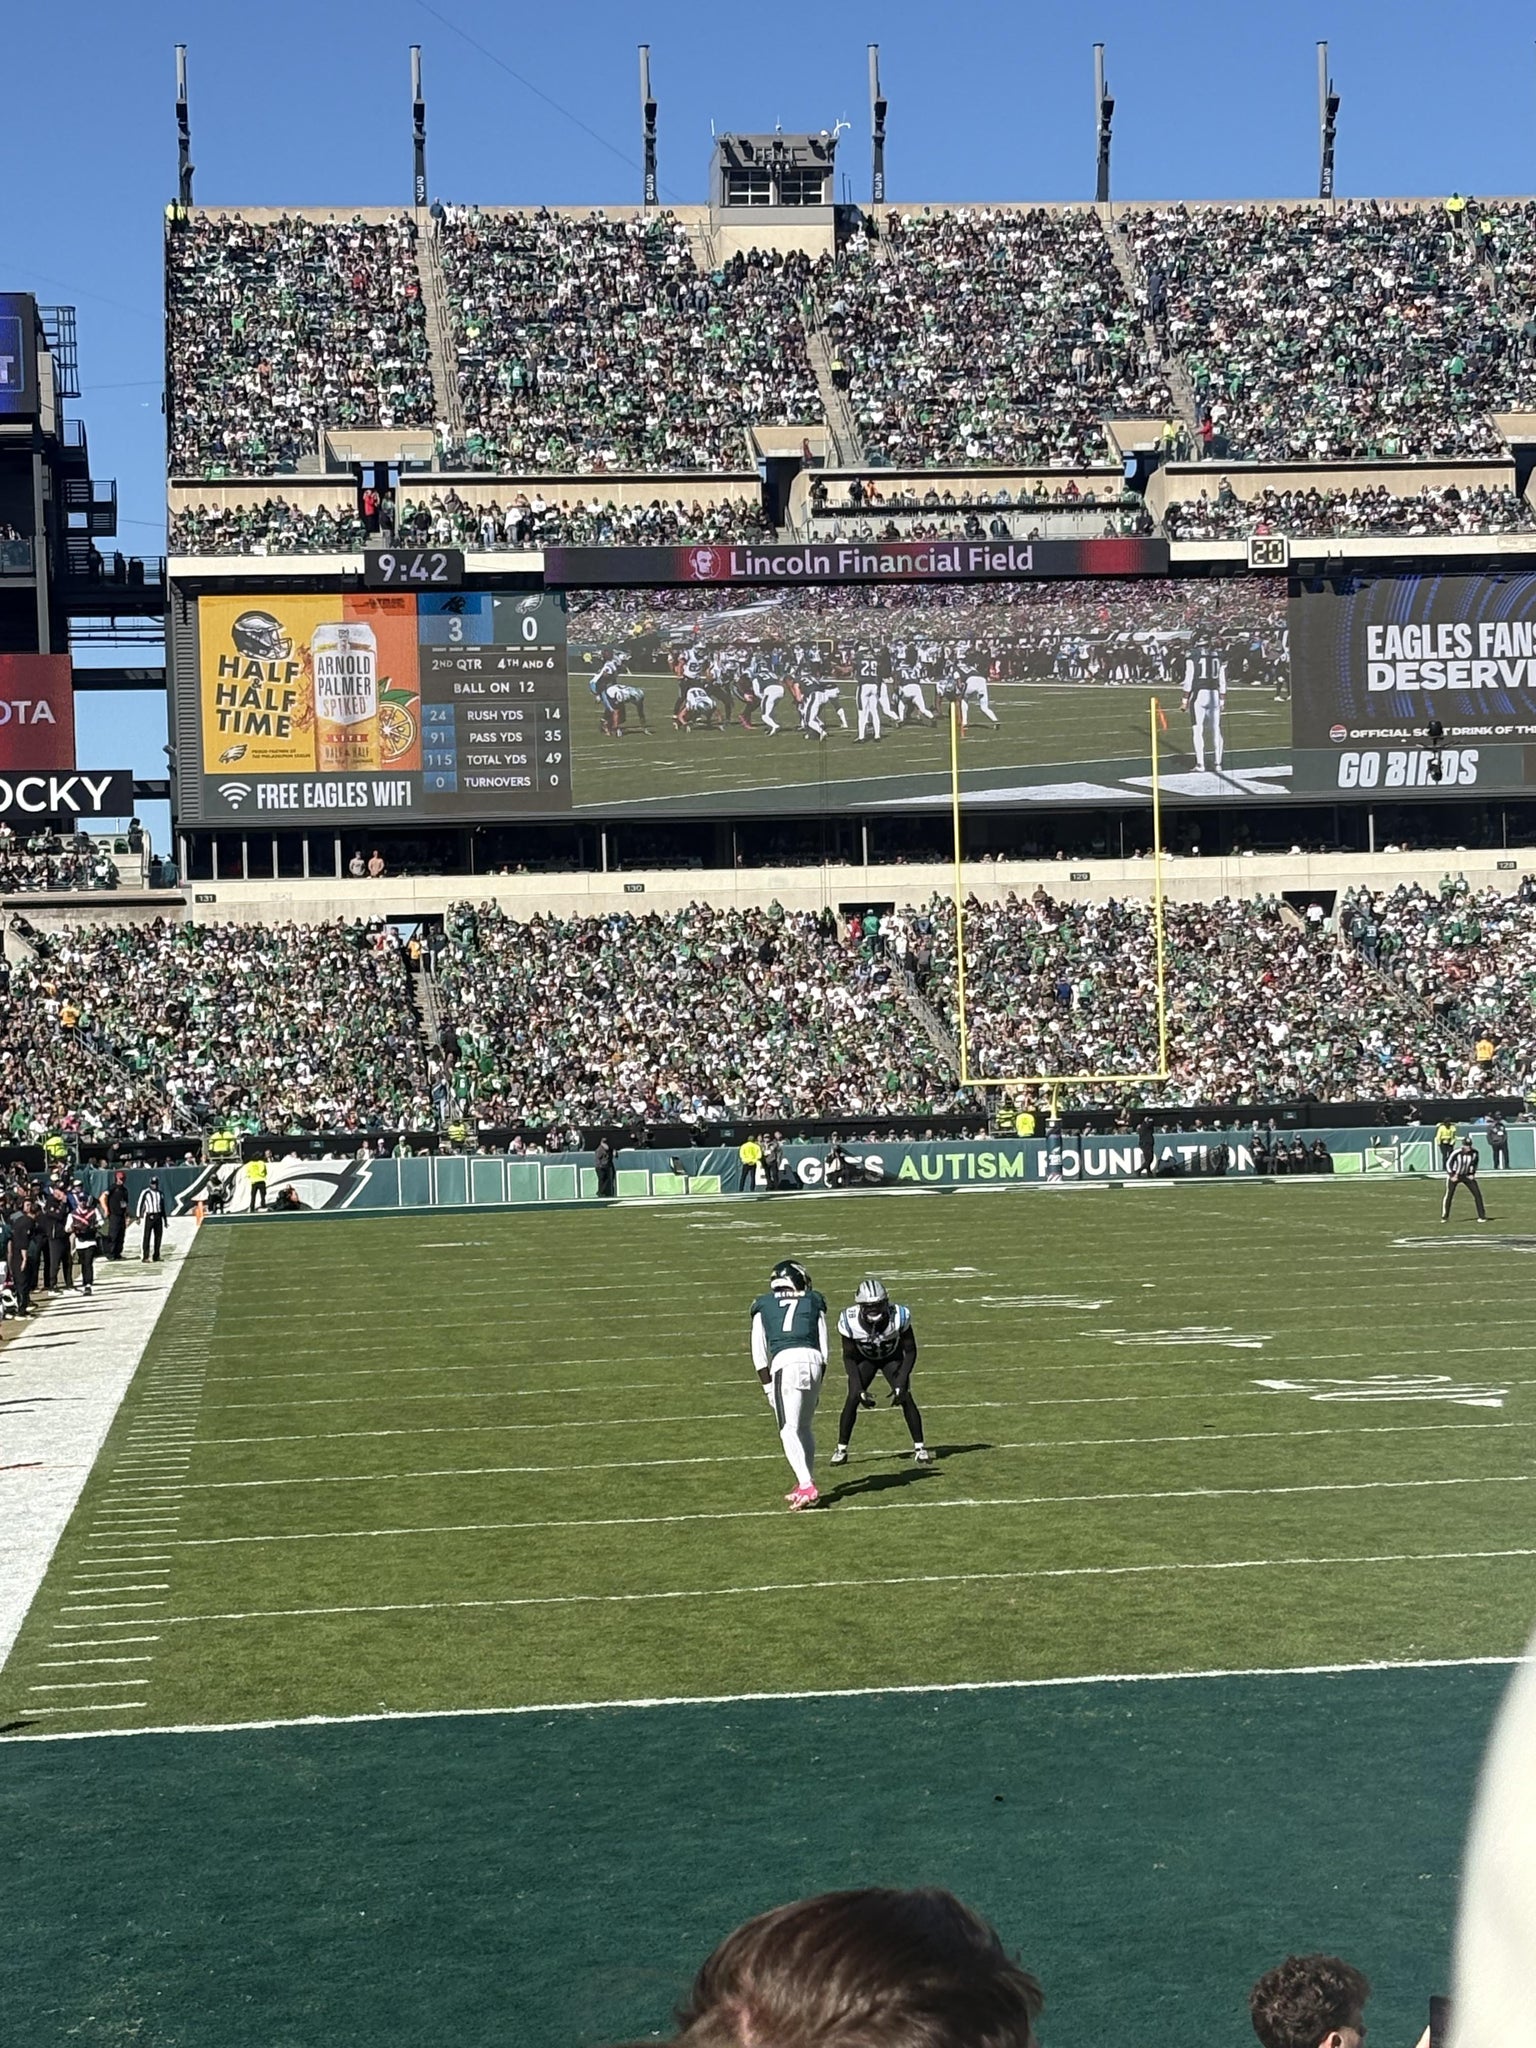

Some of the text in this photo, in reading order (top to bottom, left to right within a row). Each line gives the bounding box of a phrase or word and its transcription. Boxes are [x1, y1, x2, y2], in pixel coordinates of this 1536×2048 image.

[416, 176, 424, 202] 237
[1322, 168, 1331, 193] 234
[730, 545, 1034, 575] Lincoln Financial Field
[1253, 541, 1283, 564] 20
[378, 553, 448, 582] 9:42
[448, 617, 463, 642] 3
[522, 617, 538, 641] 0
[1366, 623, 1472, 660] EAGLES
[218, 655, 299, 684] HALF
[318, 656, 370, 675] ARNOLD
[432, 658, 482, 671] 2ND QTR
[497, 658, 555, 669] 4TH AND 6
[252, 678, 262, 689] &
[318, 677, 371, 696] PALMER
[454, 682, 535, 693] BALL ON 12
[216, 684, 297, 713] HALF
[323, 697, 366, 717] SPIKED
[216, 709, 291, 738] TIME
[430, 708, 561, 721] 24 RUSH YDS 14
[430, 730, 561, 743] 91 PASS YDS 35
[1350, 728, 1411, 738] OFFICIAL
[1413, 727, 1450, 737] SOT
[1452, 726, 1493, 736] DRINK
[1494, 726, 1513, 735] OF
[1515, 725, 1536, 734] TH
[427, 752, 562, 765] 115 TOTAL YDS 49
[1338, 752, 1380, 788] GO
[436, 775, 558, 788] 0 TURNOVERS 0
[257, 781, 411, 809] FREE EAGLES WIFI
[899, 1152, 1024, 1181] AUTISM
[779, 1299, 799, 1332] 7
